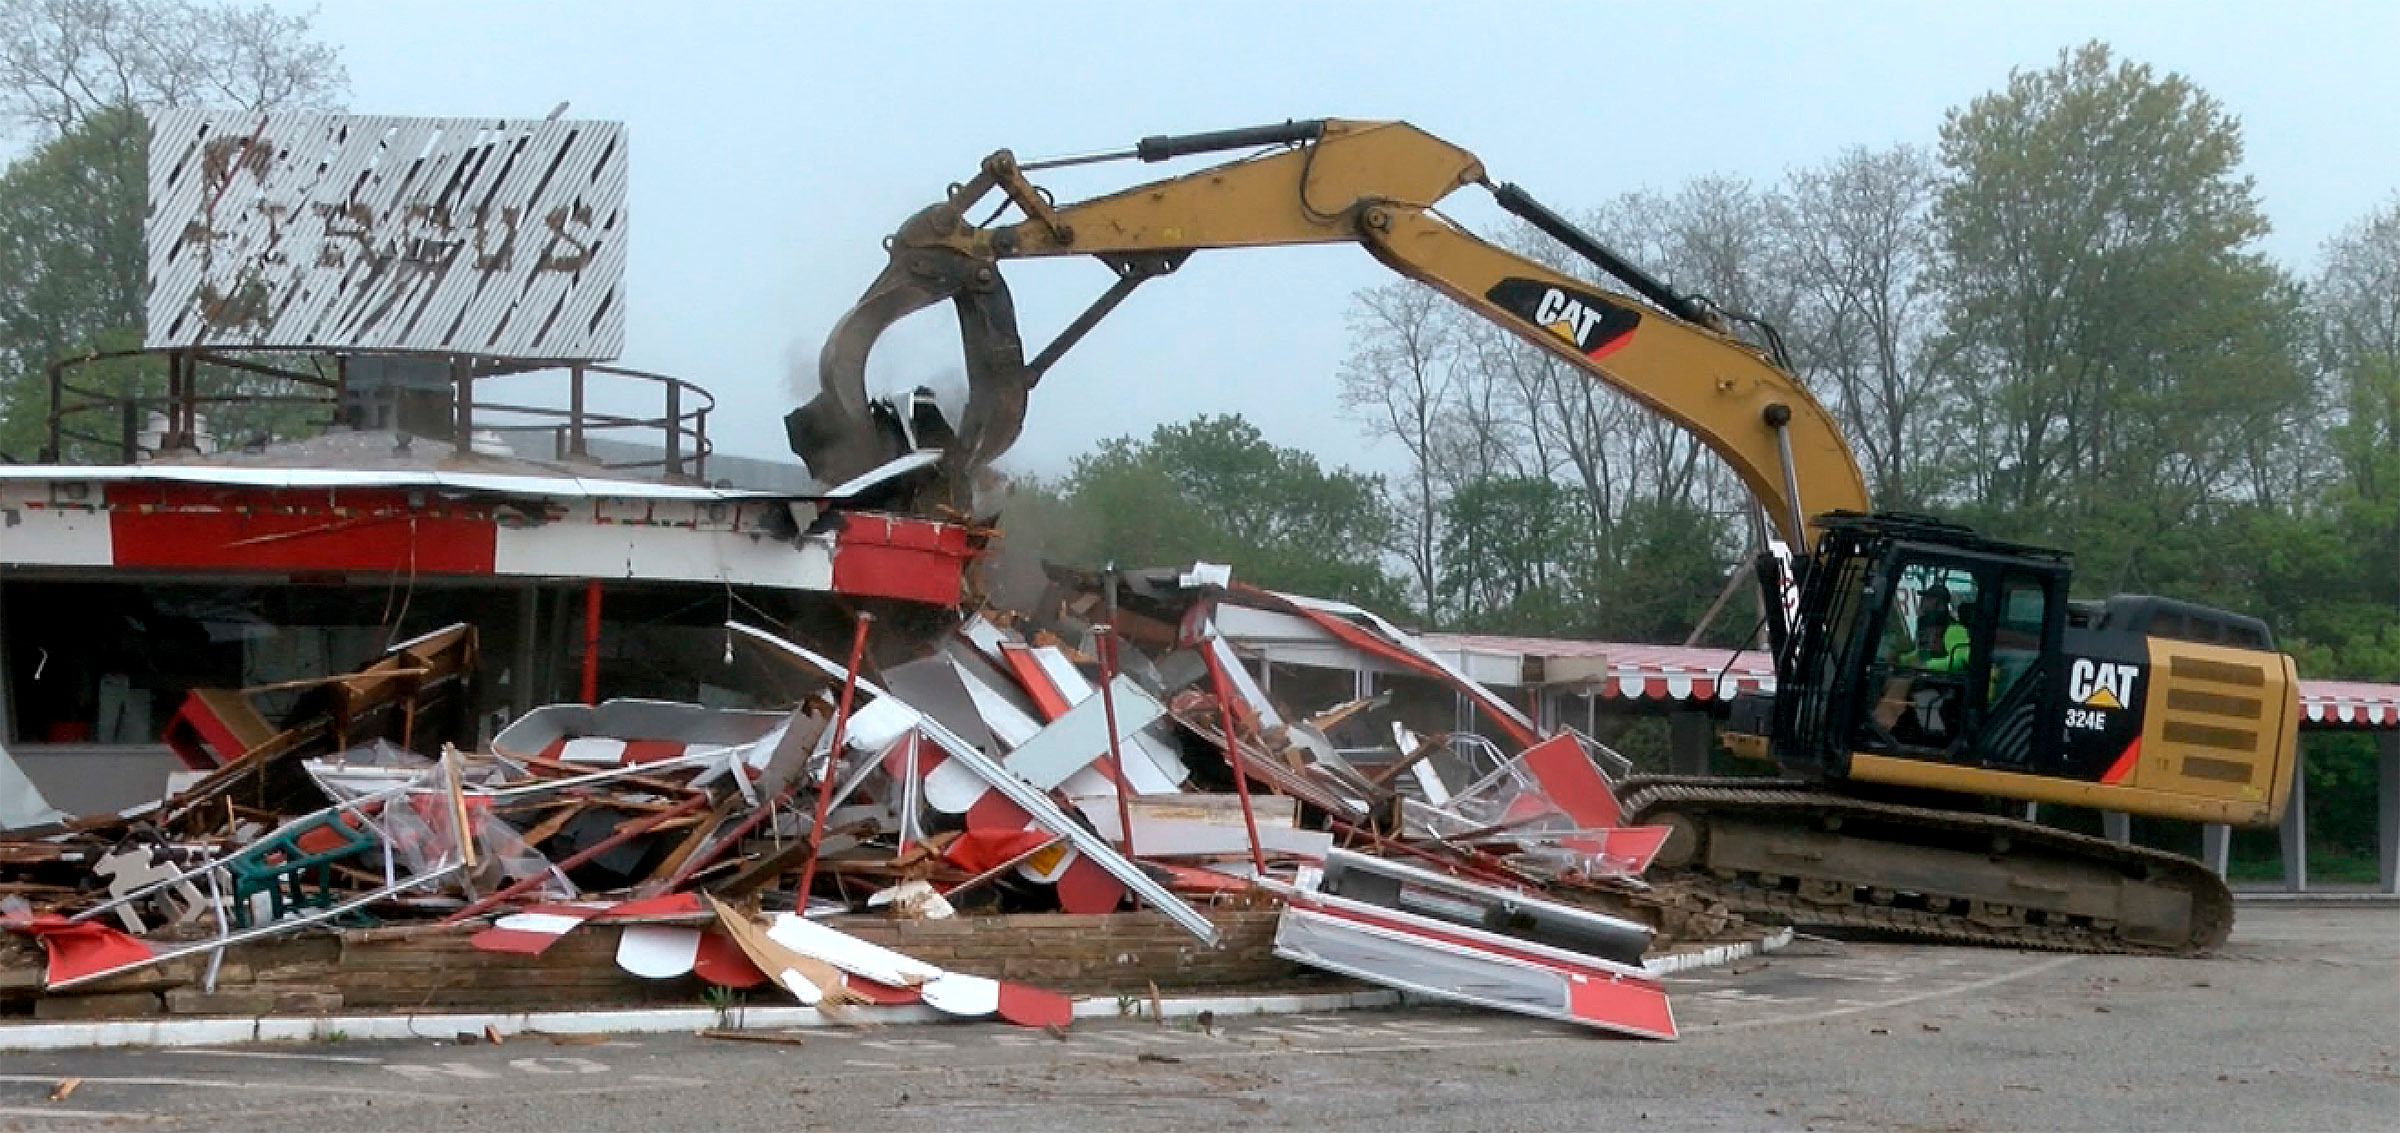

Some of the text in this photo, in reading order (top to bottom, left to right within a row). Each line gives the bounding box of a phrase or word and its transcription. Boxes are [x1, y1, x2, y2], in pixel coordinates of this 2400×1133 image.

[1535, 288, 1603, 347] CAT
[2069, 657, 2139, 710] CAT
[2065, 708, 2106, 731] 324E
